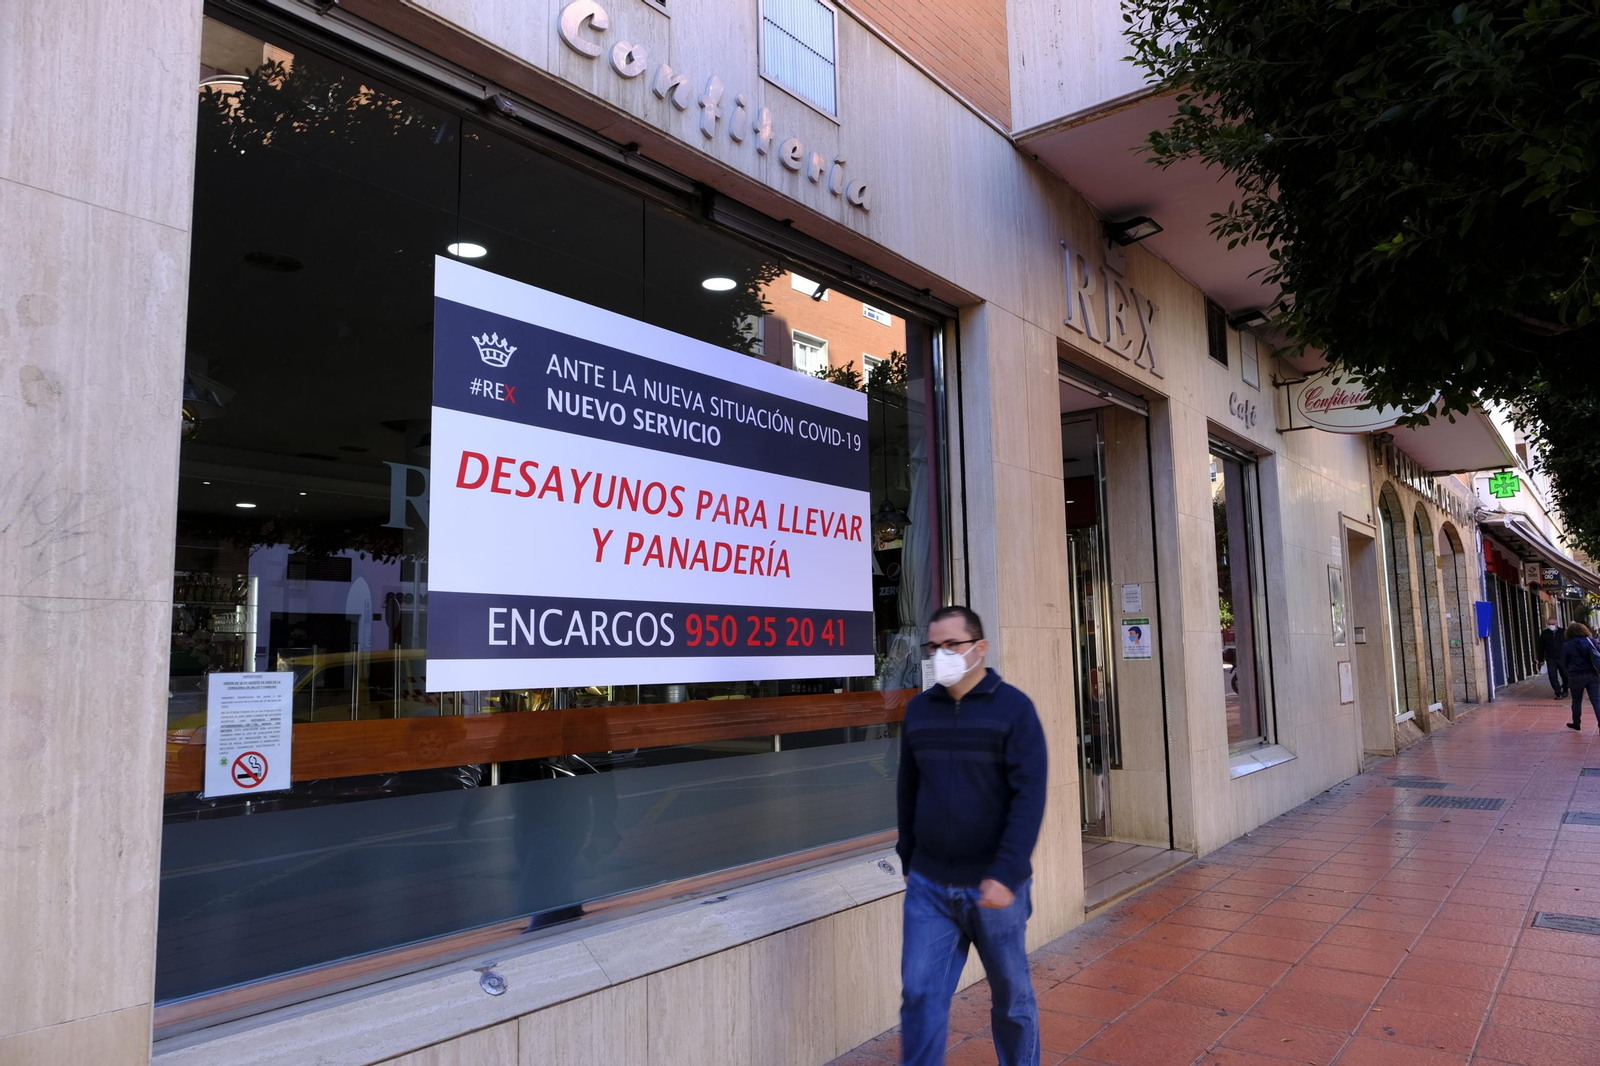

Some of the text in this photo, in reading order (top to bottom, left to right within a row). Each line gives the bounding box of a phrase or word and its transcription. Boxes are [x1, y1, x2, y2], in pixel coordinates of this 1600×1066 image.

[1060, 239, 1164, 380] REX
[470, 378, 516, 404] #REX
[546, 354, 861, 451] ANTE LA NUEVA SITUACIÓN COVID-19
[547, 387, 721, 447] NUEVO SERVICIO
[1229, 391, 1257, 430] Café
[456, 450, 863, 542] DESAYUNOS PARA LLEVAR
[593, 527, 791, 578] Y PANADERÍA
[488, 607, 845, 647] ENCARGOS 950 25 20 41
